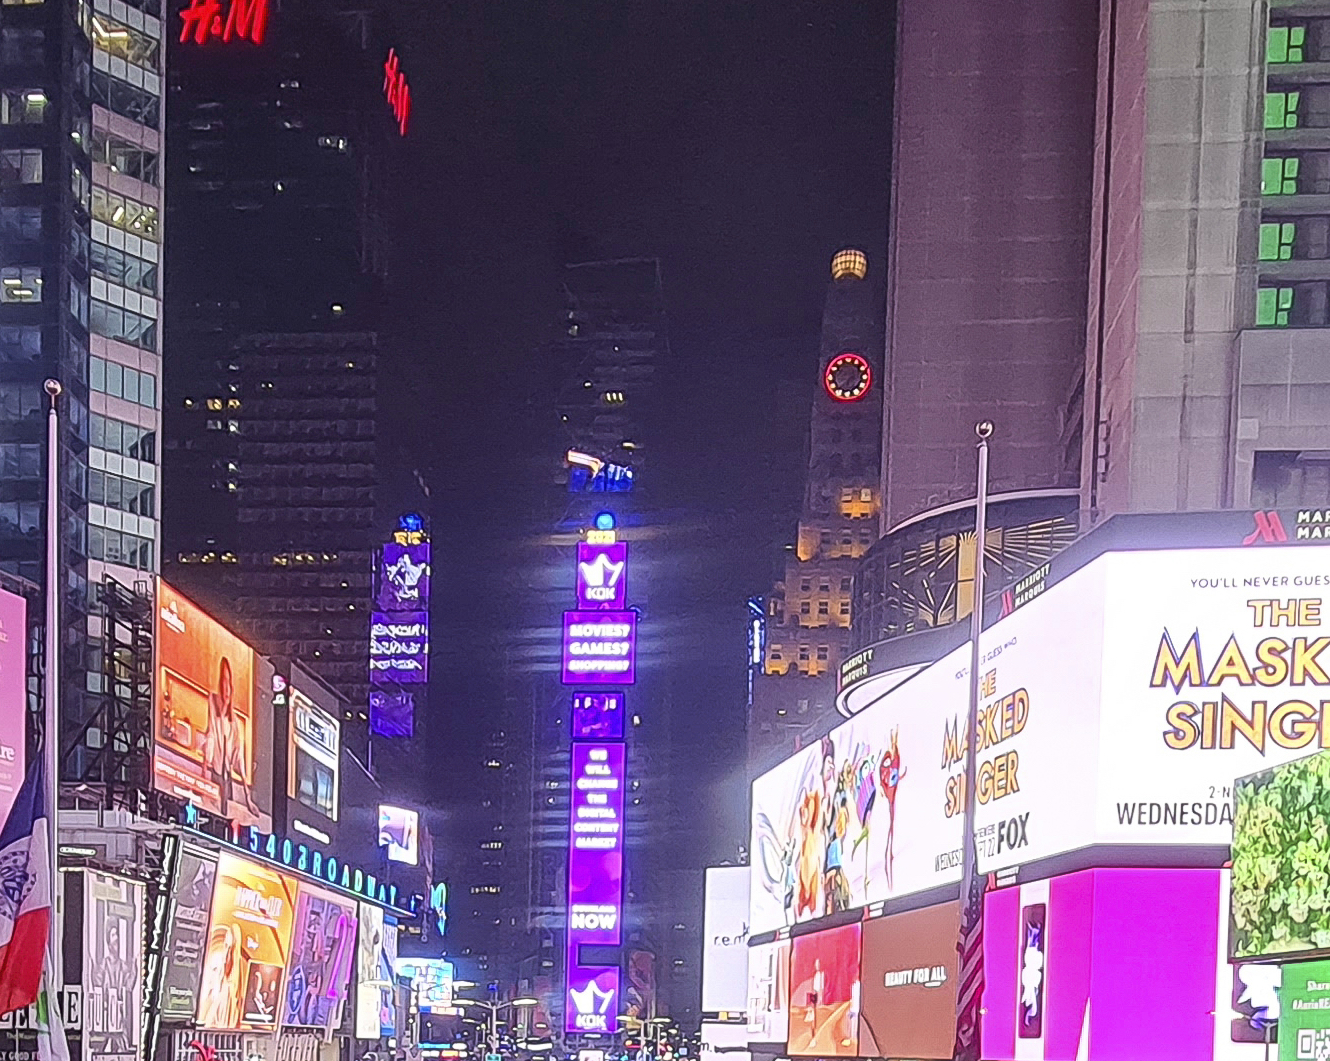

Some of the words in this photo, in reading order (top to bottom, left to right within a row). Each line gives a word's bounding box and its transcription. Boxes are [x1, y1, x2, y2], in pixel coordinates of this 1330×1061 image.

[179, 0, 269, 45] H&M
[1015, 563, 1052, 594] MARRIOTT
[1190, 577, 1238, 589] YOU'LL
[1243, 576, 1289, 588] NEVER
[1015, 580, 1045, 608] MARQUIS
[1246, 598, 1322, 628] THE
[569, 624, 631, 637] MOVIES?
[569, 641, 631, 655] GAMES?
[979, 668, 997, 701] HE
[1116, 802, 1234, 826] WEDNESDA
[996, 811, 1030, 855] FOX
[935, 847, 964, 873] WEDNES
[298, 845, 397, 907] BROADWAY
[571, 914, 616, 930] NOW
[885, 970, 912, 987] BEAUTY
[913, 968, 930, 984] FOR
[930, 965, 947, 982] ALL
[576, 1015, 607, 1028] KOK
